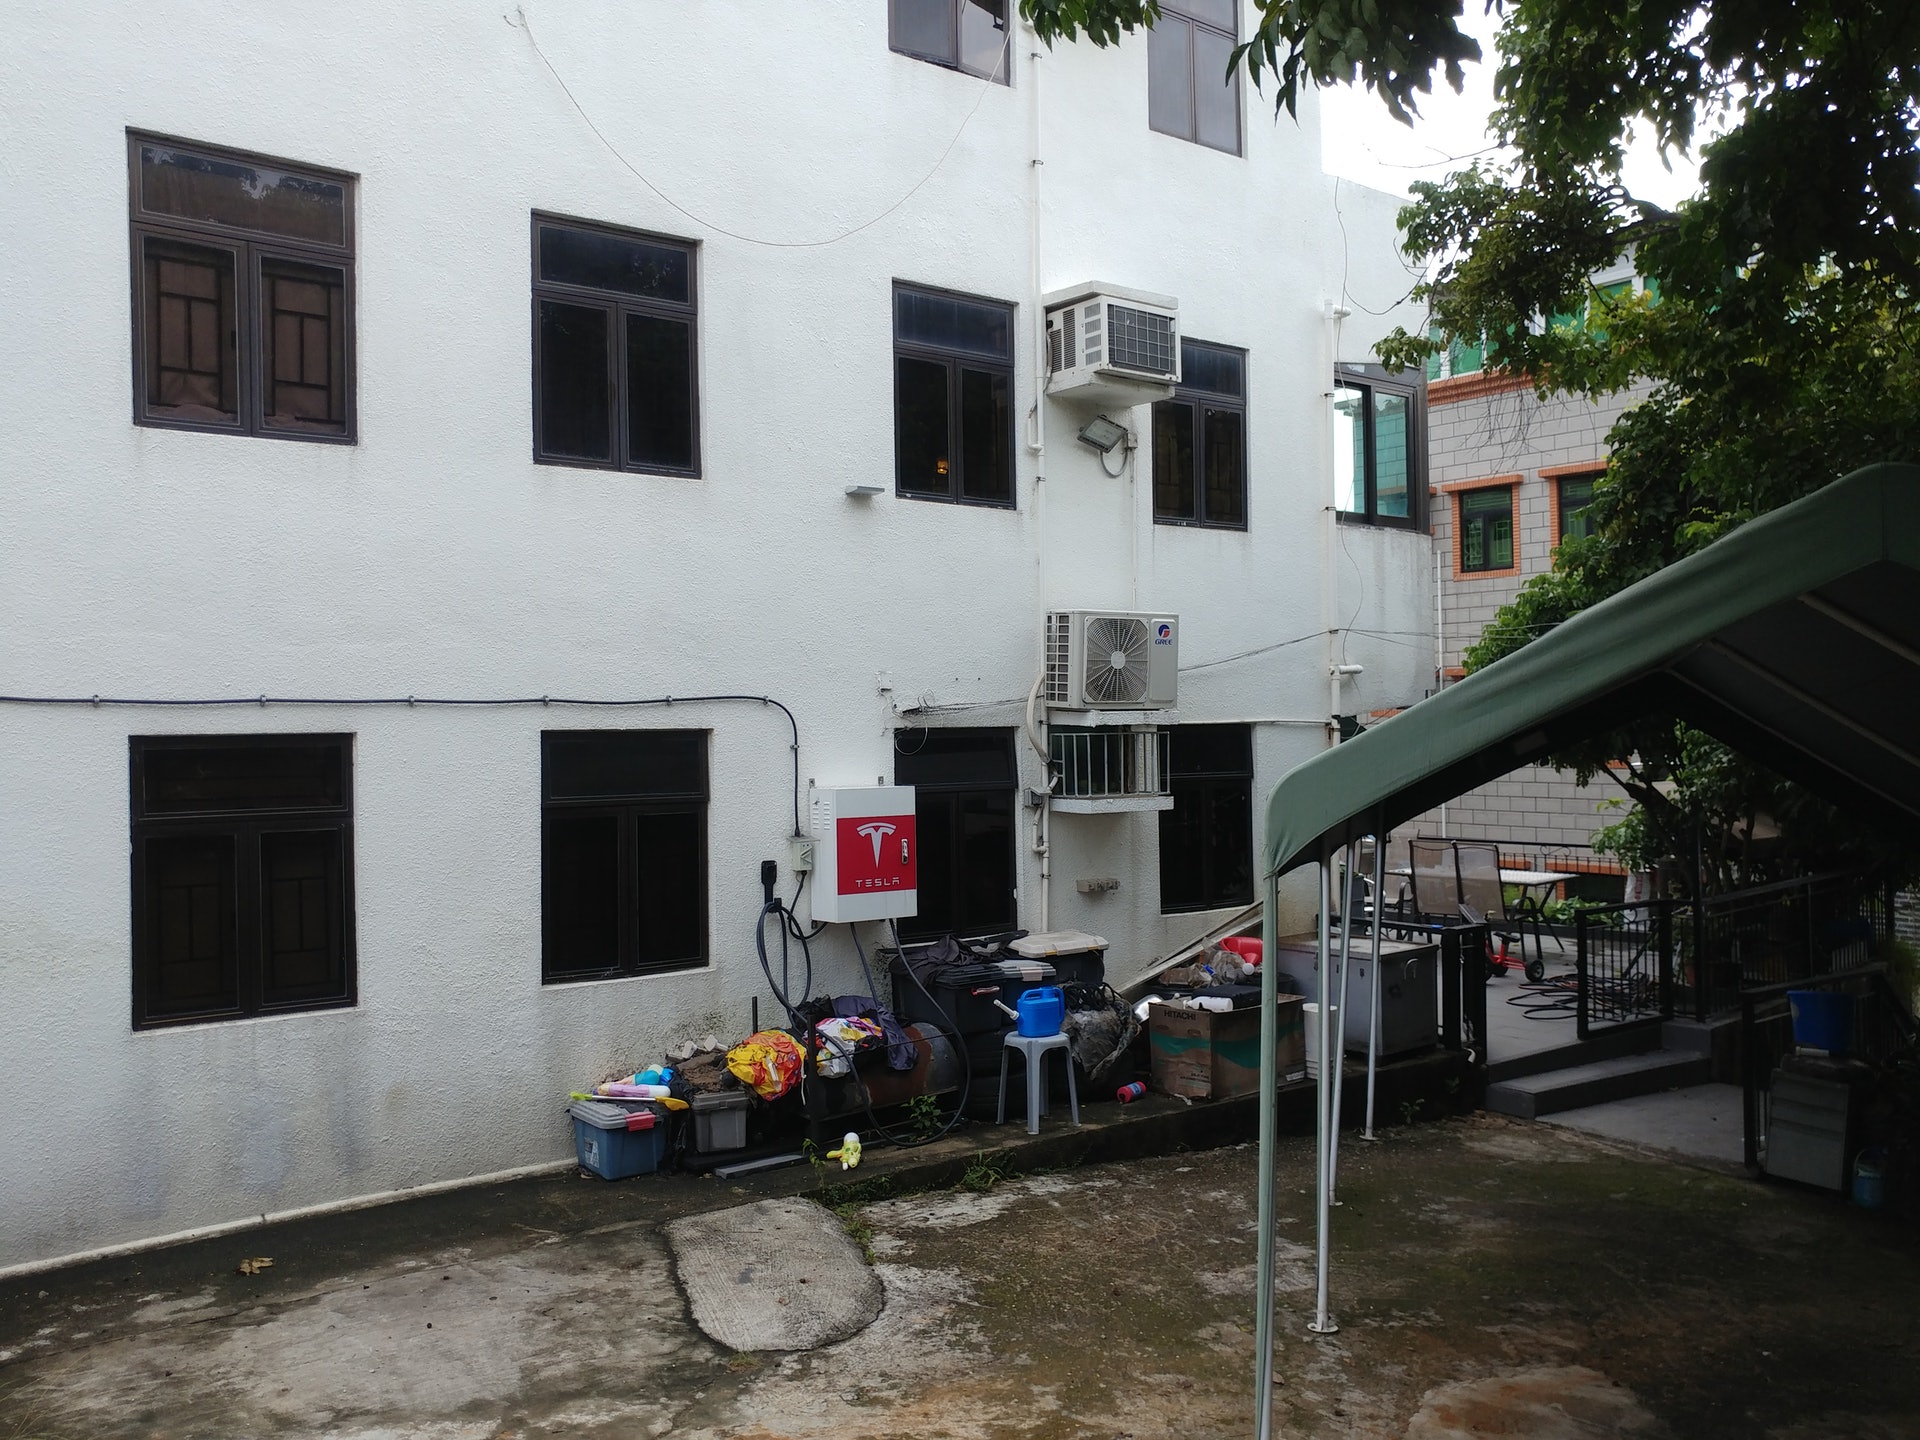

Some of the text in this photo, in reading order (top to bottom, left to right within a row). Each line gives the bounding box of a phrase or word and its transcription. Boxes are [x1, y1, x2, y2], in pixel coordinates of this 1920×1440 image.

[1154, 638, 1173, 646] GREE
[855, 877, 900, 888] TESLA
[1164, 1010, 1196, 1021] HITACHI
